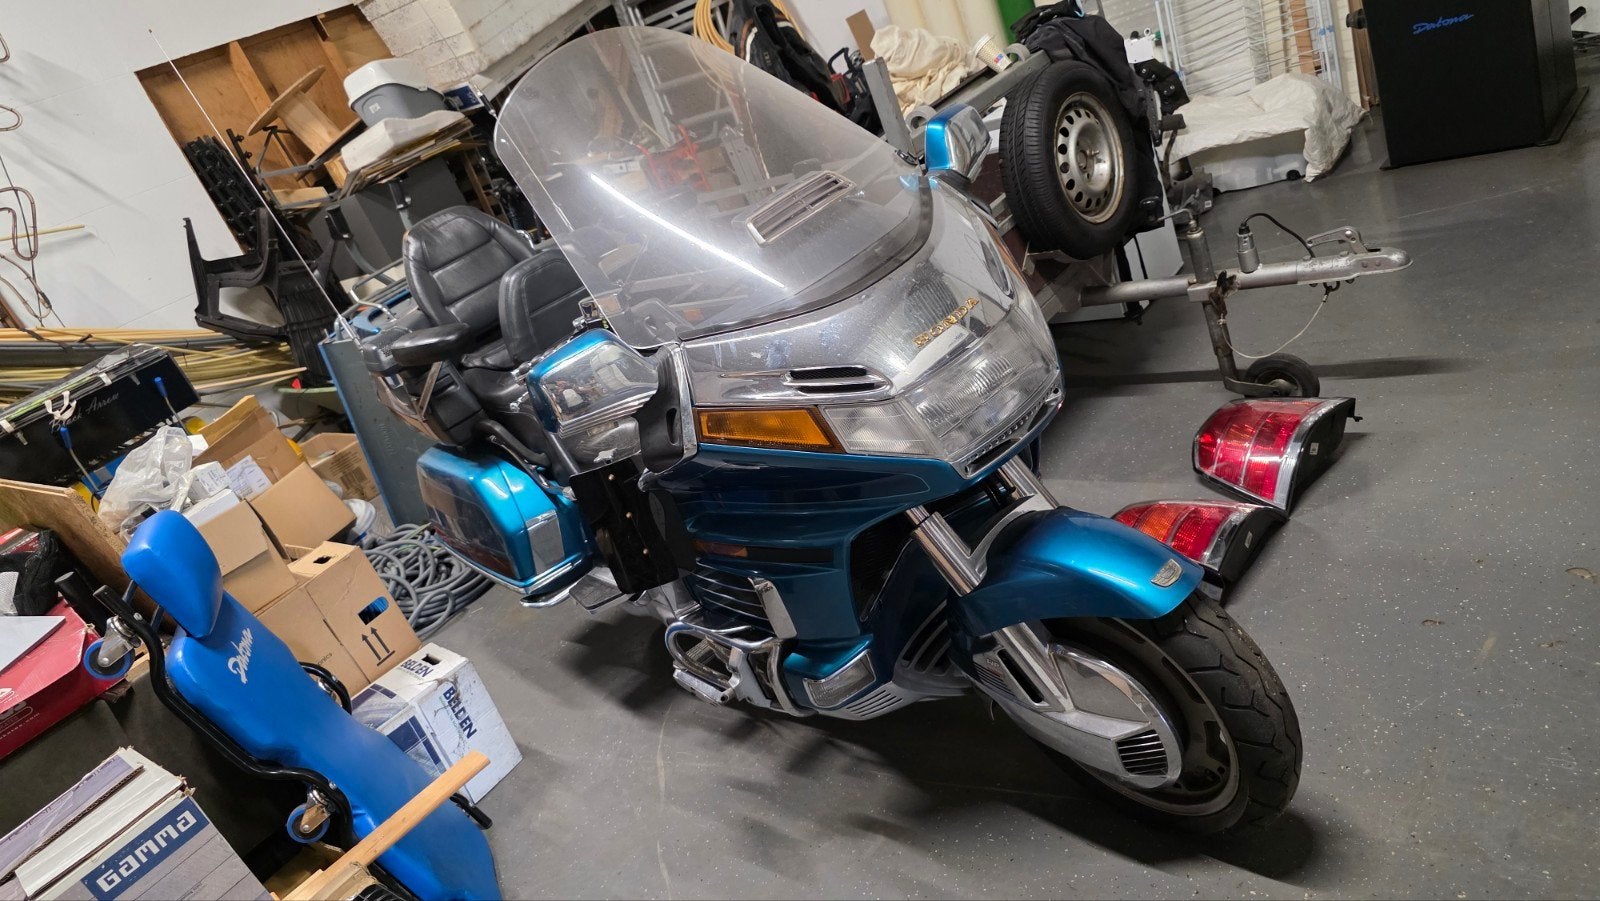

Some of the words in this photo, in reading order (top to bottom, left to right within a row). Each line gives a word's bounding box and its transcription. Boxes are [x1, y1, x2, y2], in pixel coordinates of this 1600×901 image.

[1412, 13, 1475, 35] Datona
[913, 296, 979, 348] HONDA
[227, 627, 254, 684] Datona
[400, 658, 434, 678] BELDEN
[443, 686, 478, 740] BELDEN
